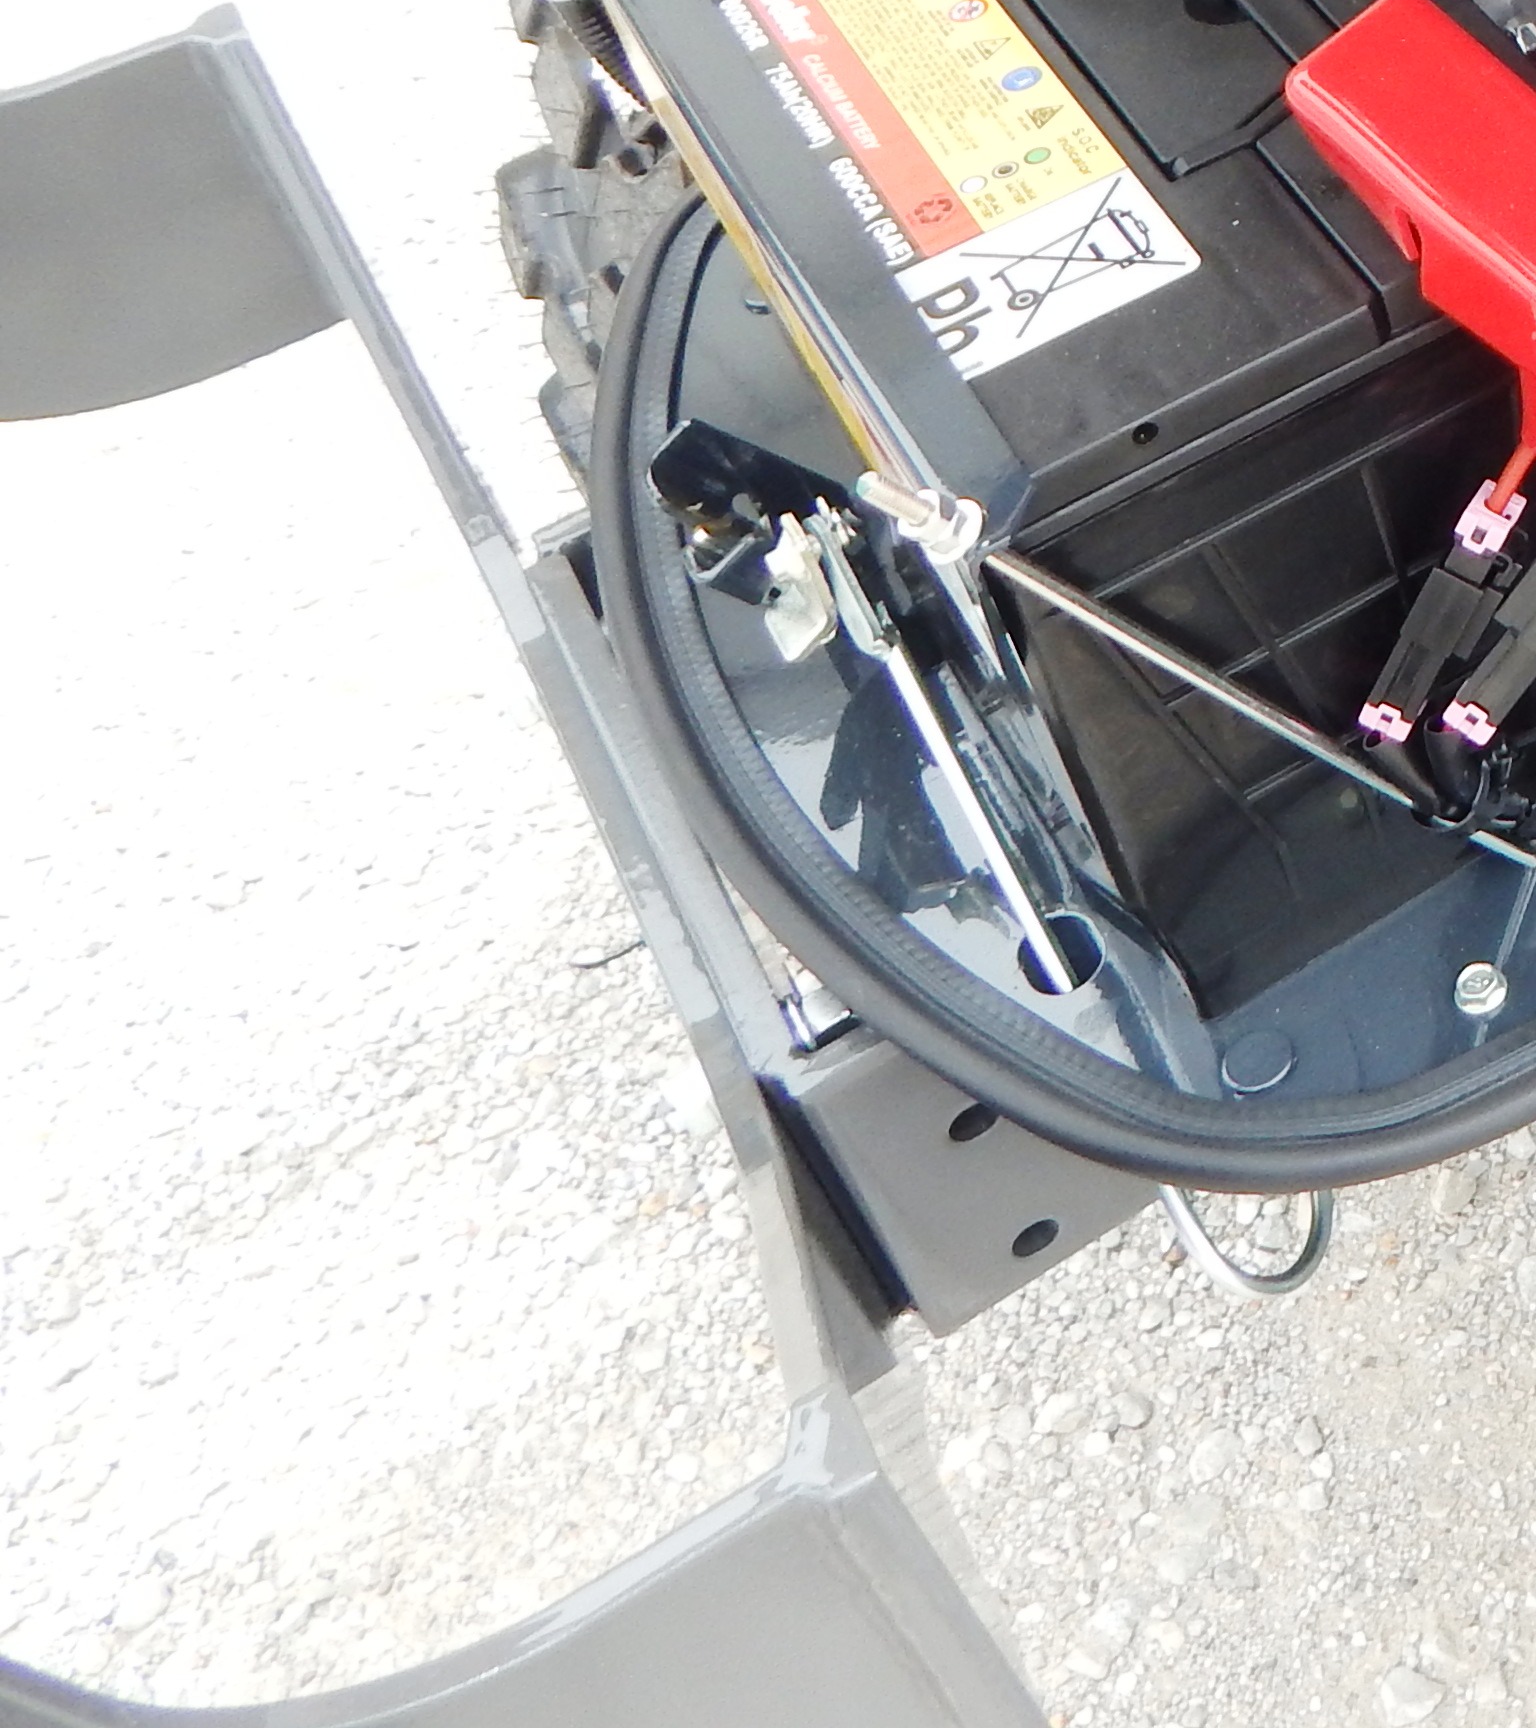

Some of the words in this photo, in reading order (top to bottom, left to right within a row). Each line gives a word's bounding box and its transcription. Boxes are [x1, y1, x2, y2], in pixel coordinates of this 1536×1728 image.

[802, 53, 848, 104] CALCIUM
[834, 101, 881, 150] BATTERY
[828, 156, 885, 222] 600CCA
[864, 217, 915, 266] (SAE)
